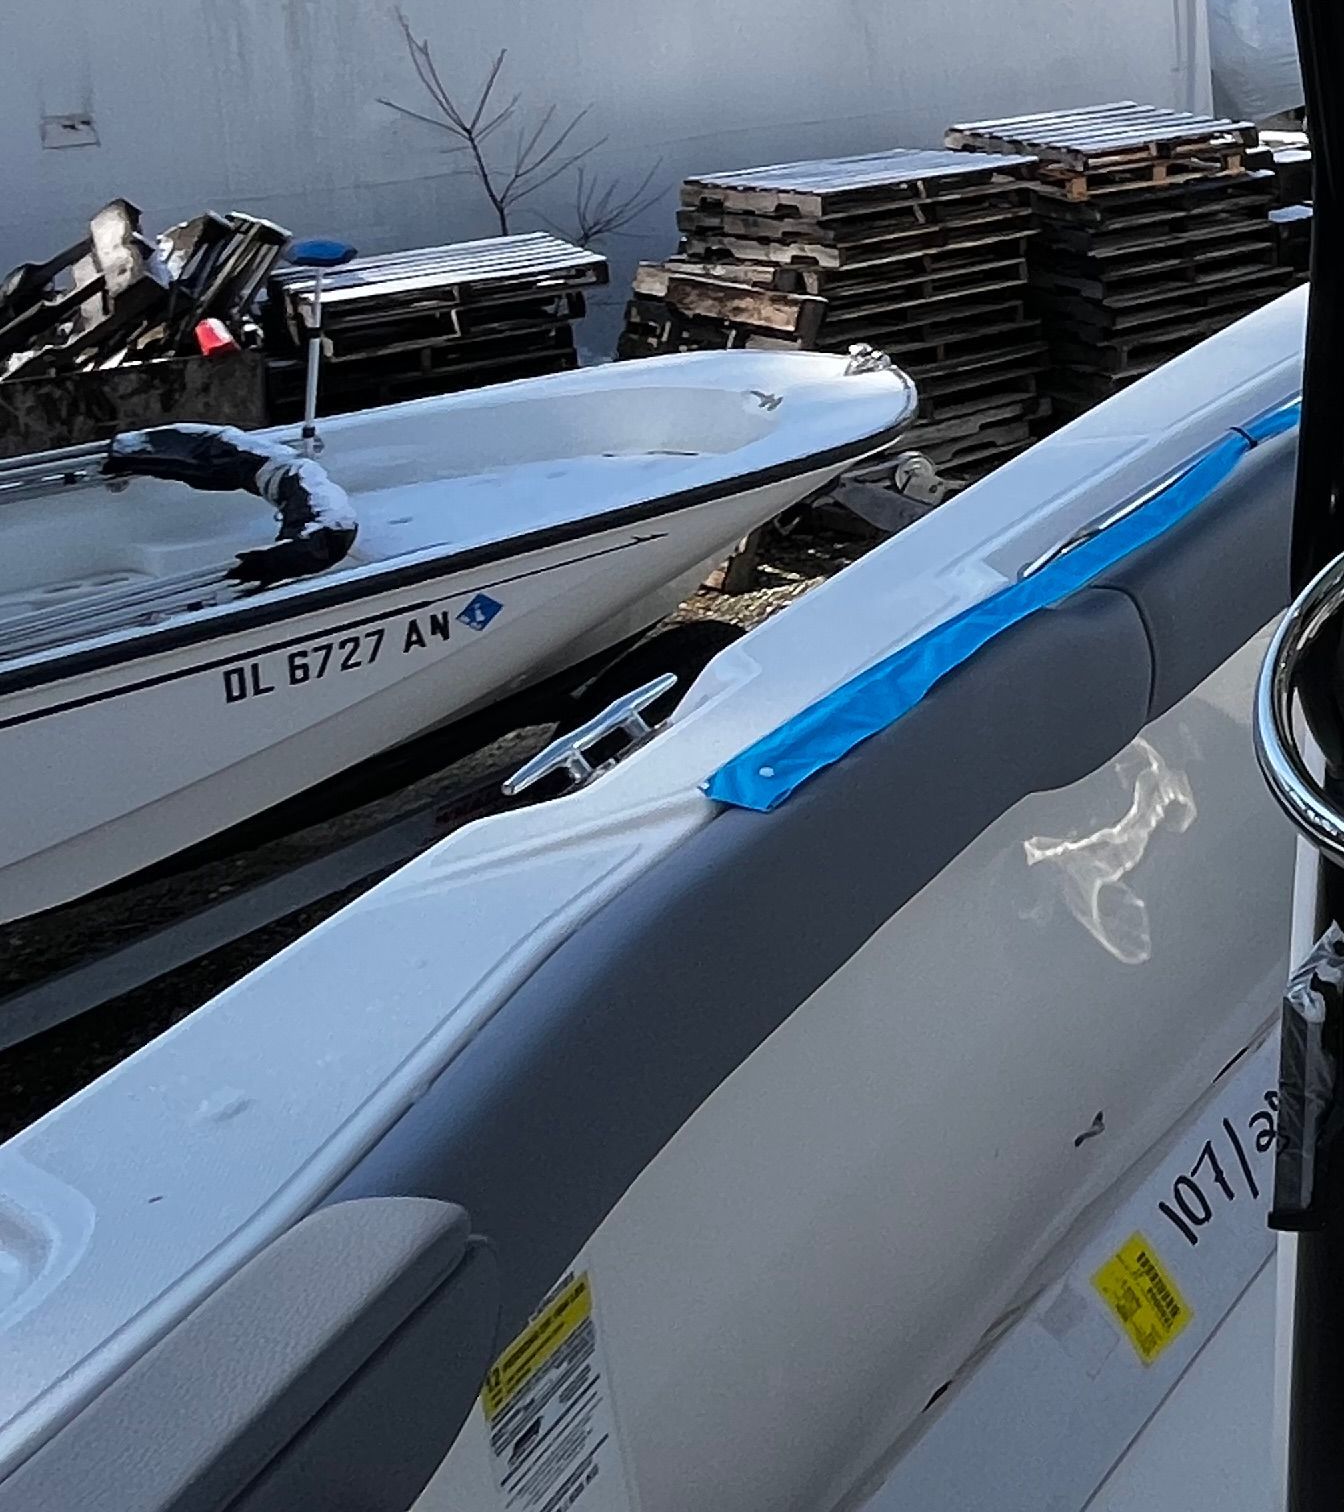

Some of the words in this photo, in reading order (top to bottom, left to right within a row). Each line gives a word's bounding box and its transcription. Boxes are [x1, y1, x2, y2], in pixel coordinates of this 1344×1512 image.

[223, 662, 275, 704] DL
[287, 628, 386, 686] 6727
[402, 611, 450, 654] AN
